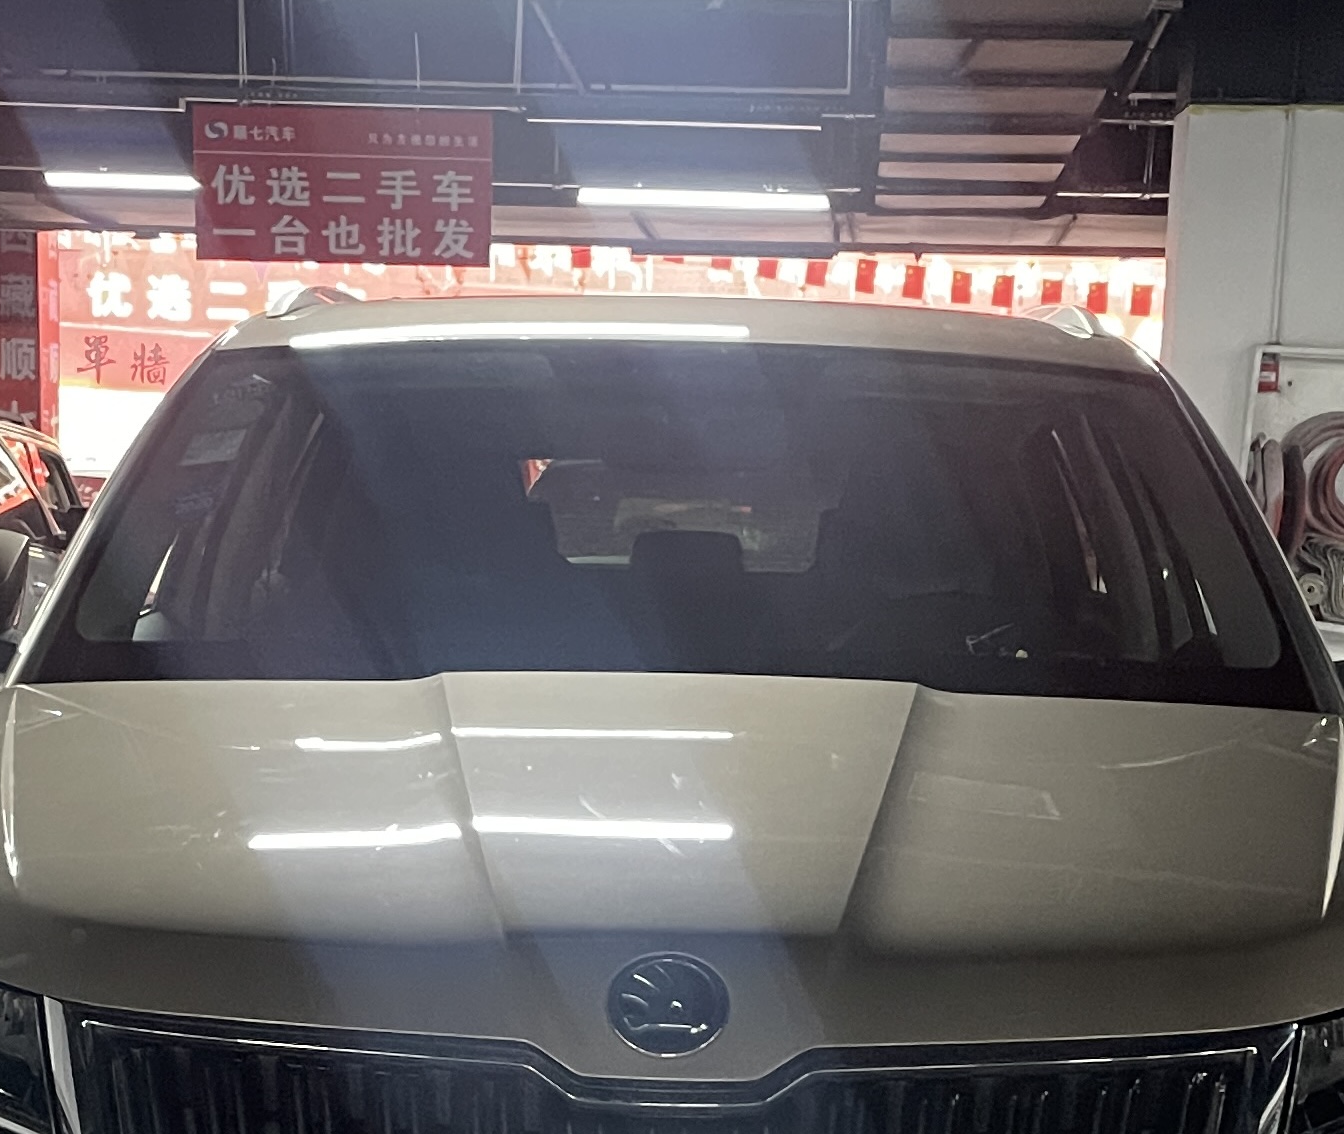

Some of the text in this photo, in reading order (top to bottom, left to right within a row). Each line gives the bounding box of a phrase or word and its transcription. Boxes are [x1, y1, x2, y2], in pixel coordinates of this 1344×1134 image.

[210, 164, 475, 212] 优选二手车
[212, 214, 475, 259] 一台也批发
